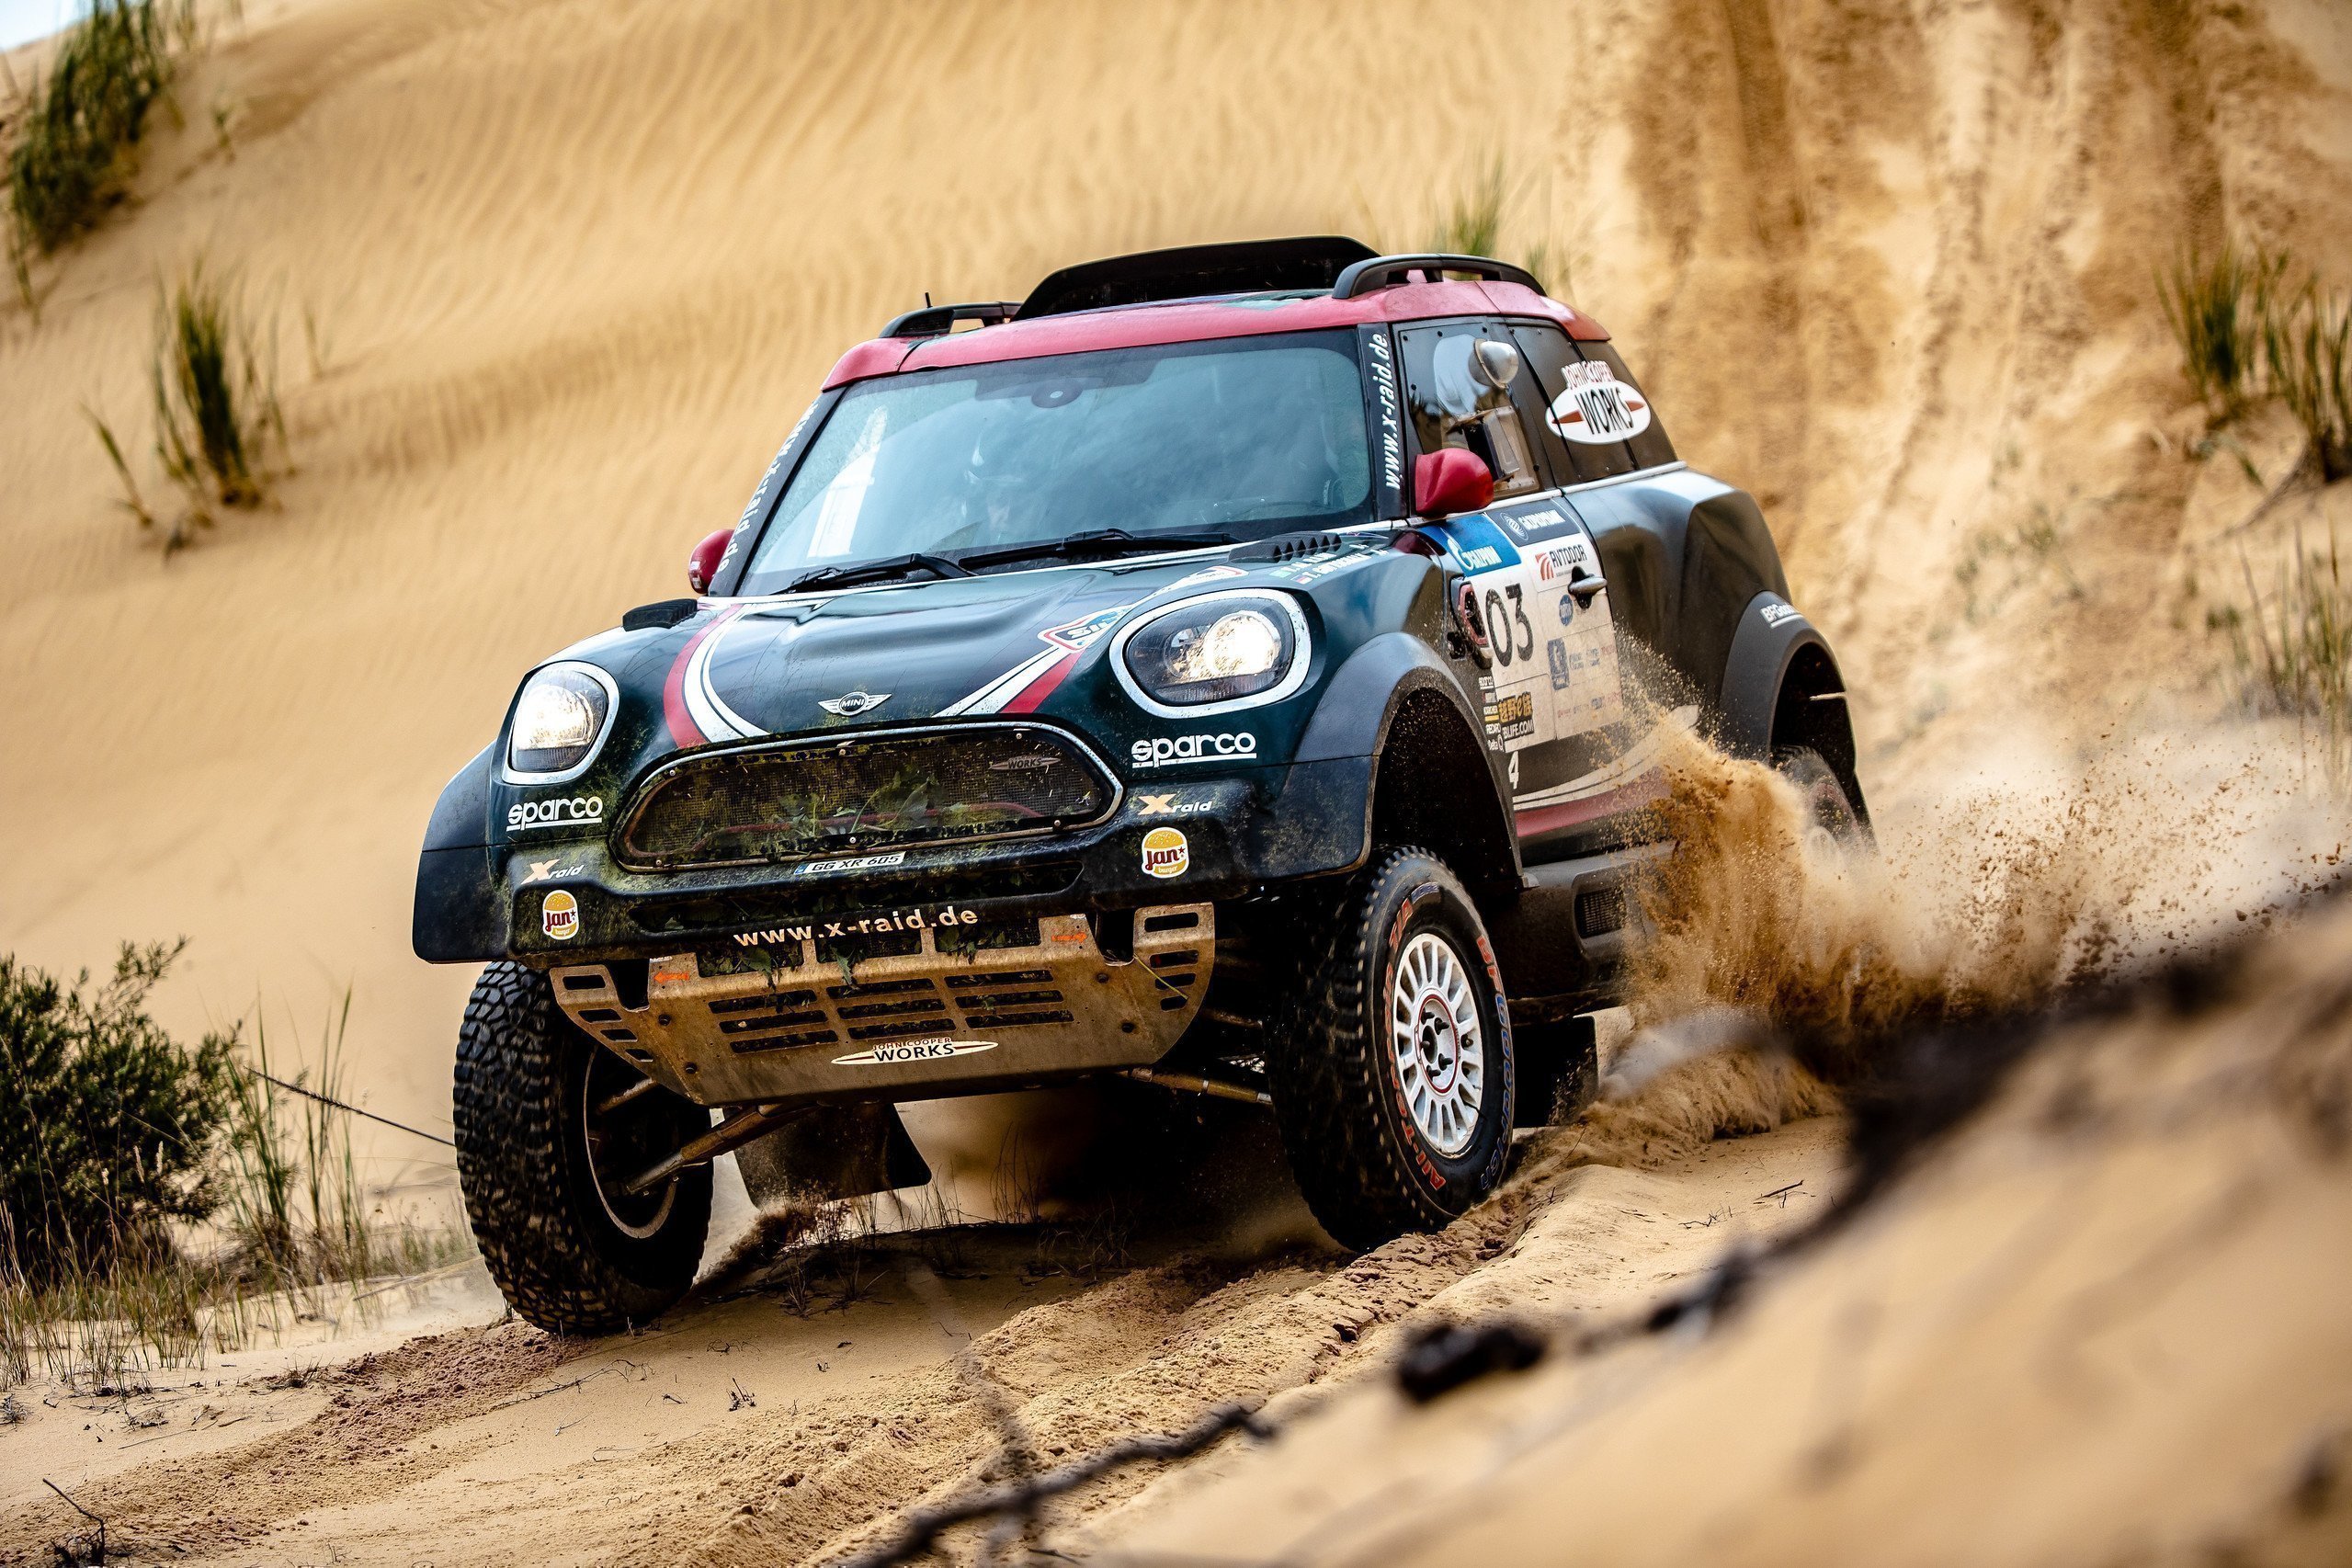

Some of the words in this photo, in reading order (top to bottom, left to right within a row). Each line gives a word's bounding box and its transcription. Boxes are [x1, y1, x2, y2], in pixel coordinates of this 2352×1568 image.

[1369, 333, 1402, 490] www.x-raid.de
[1574, 387, 1633, 435] WORKS
[1550, 544, 1588, 567] AVTODOR
[1485, 583, 1534, 666] 03
[841, 698, 865, 707] MINI
[1008, 757, 1042, 769] WORKS
[1131, 732, 1256, 767] sparco
[507, 795, 604, 831] sparco
[812, 861, 838, 871] GG
[838, 858, 865, 869] XR
[867, 855, 901, 866] 605
[733, 905, 979, 947] www.x-raid.de
[874, 1041, 903, 1051] JOHN
[905, 1037, 952, 1047] COOPER
[874, 1043, 955, 1062] WORKS
